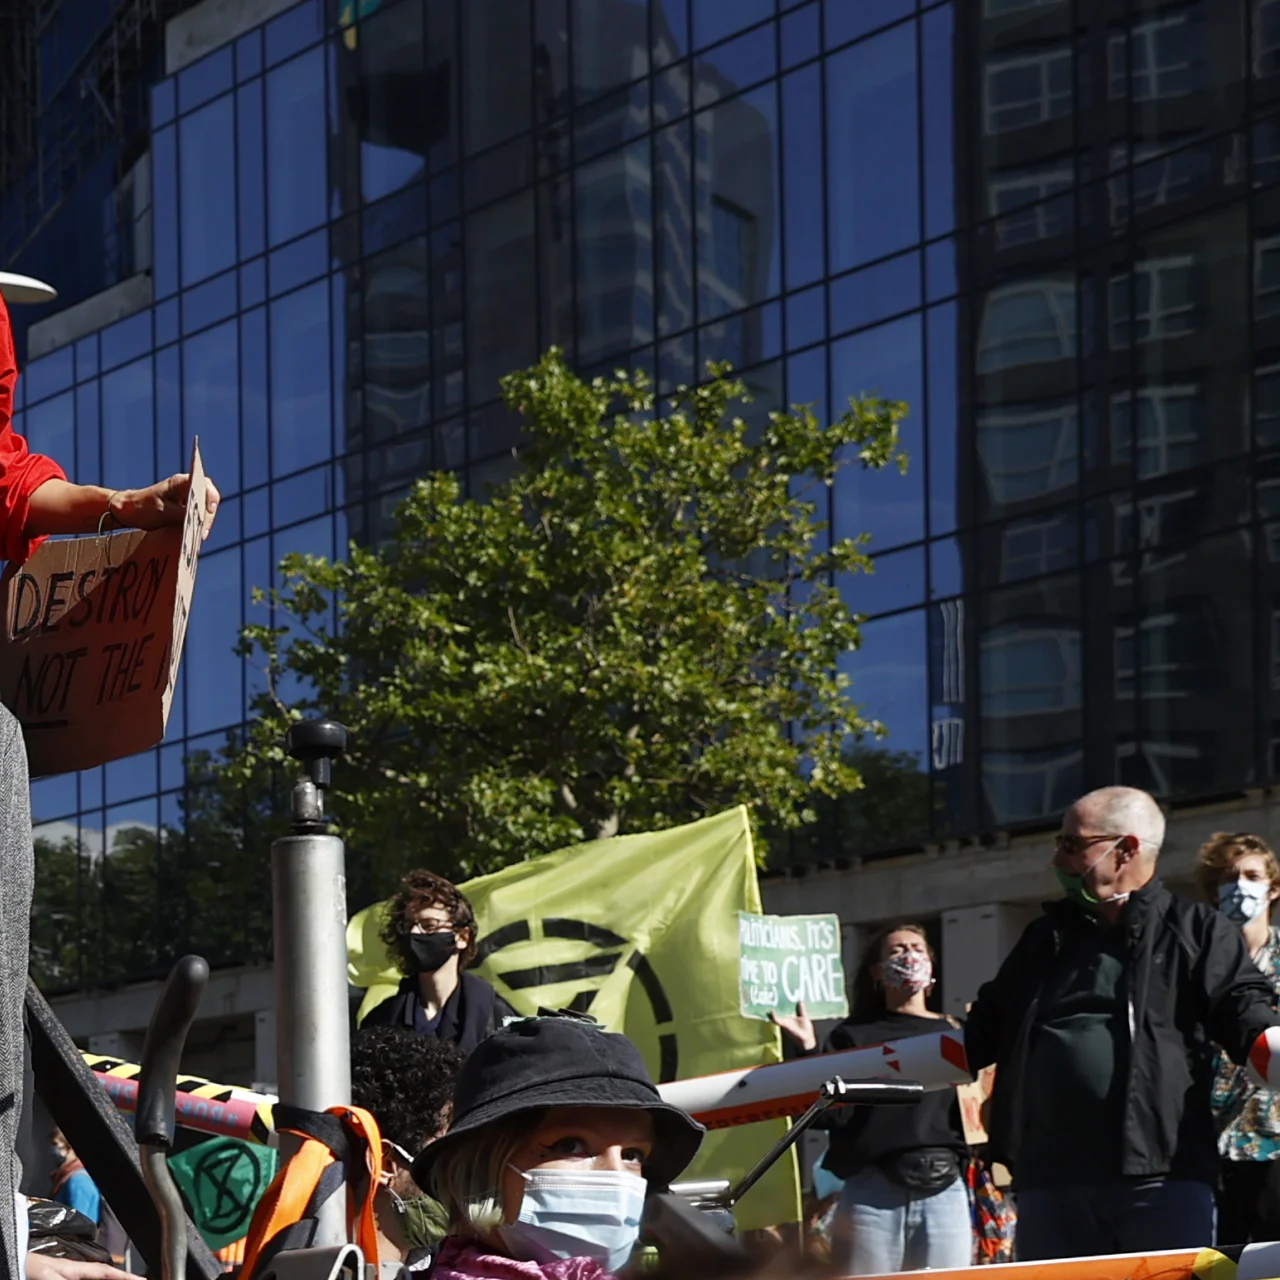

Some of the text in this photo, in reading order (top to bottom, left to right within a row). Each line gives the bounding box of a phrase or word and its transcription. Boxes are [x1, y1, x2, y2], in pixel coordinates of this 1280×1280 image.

[11, 555, 169, 639] DESTROY
[15, 645, 89, 716] NOT
[96, 632, 155, 706] THE
[760, 960, 778, 984] TO
[781, 953, 845, 1002] CARE
